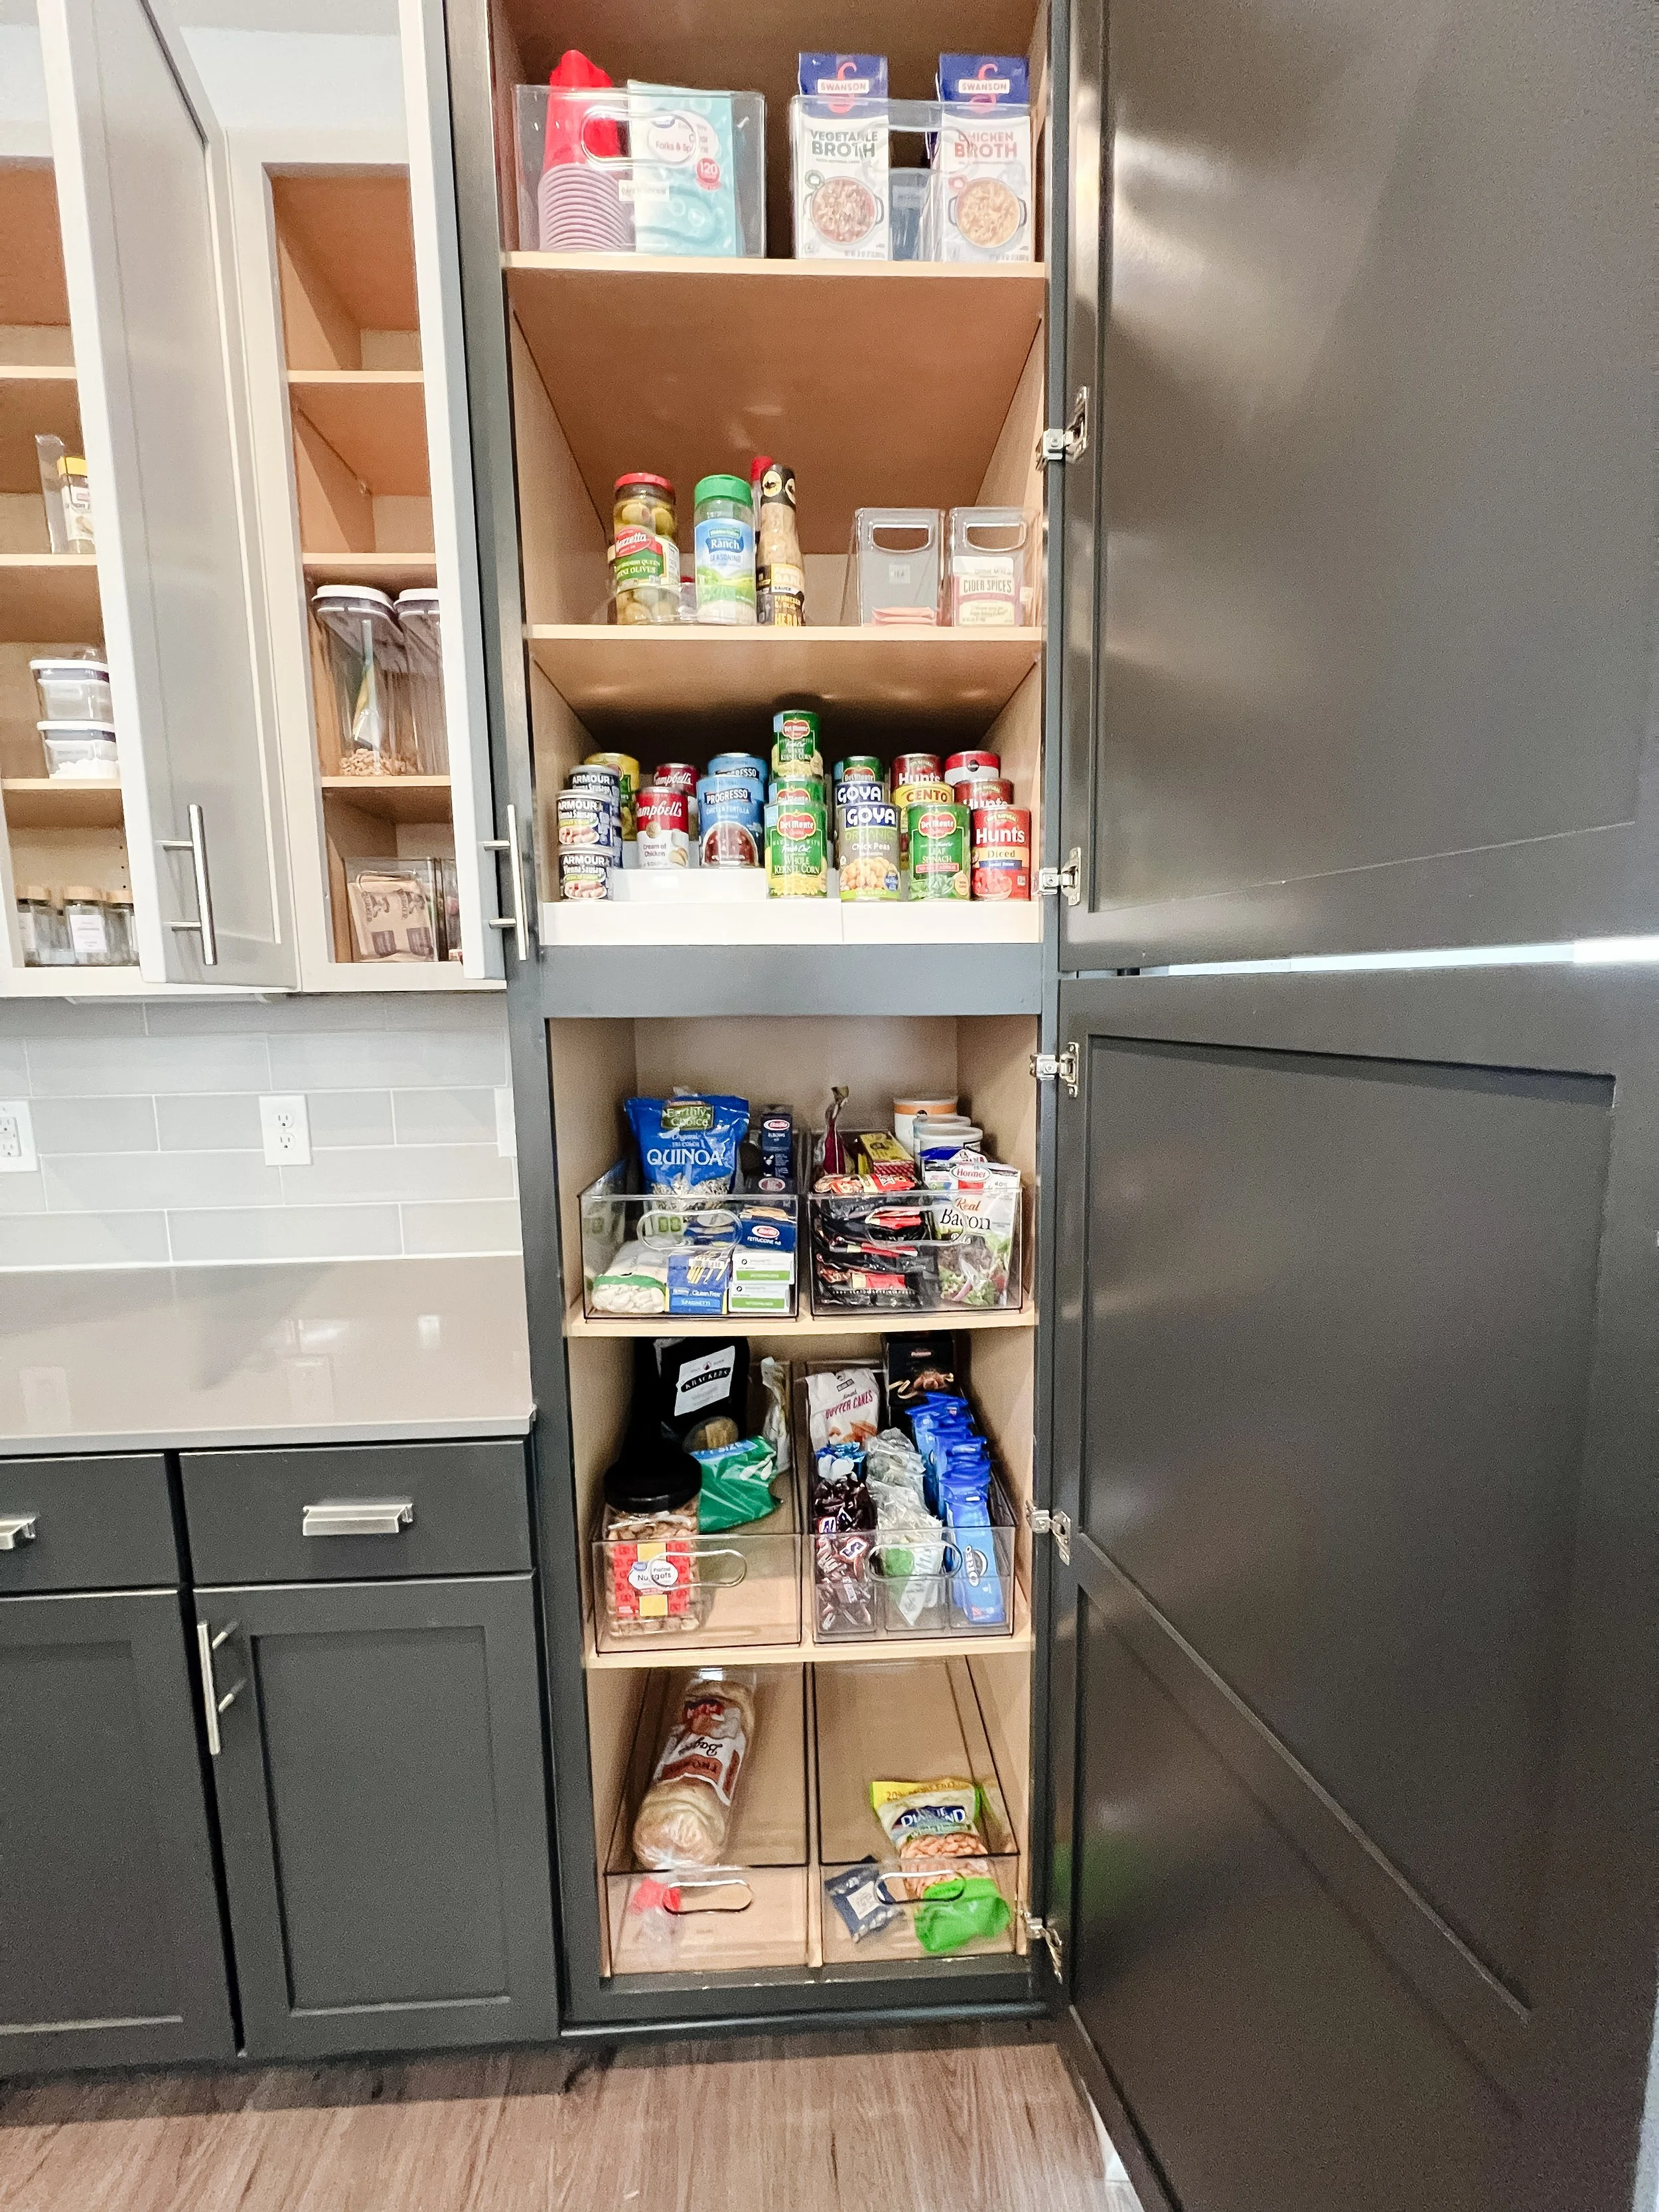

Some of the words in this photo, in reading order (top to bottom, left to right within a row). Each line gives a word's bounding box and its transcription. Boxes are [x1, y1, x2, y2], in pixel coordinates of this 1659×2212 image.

[820, 82, 867, 92] SWANSON
[962, 82, 1007, 92] SWANSON
[958, 132, 1014, 142] CHICKEN
[812, 141, 875, 159] BROTH
[954, 142, 1018, 159] BROTH
[699, 162, 718, 174] 120
[711, 540, 740, 550] Ranch
[710, 553, 741, 563] SEASONING
[964, 579, 985, 593] CIDER
[987, 579, 1012, 593] SPICES
[573, 774, 611, 784] ARMOUR
[706, 789, 748, 804] PROGRESSO
[837, 786, 882, 804] GOYA
[906, 789, 948, 802] CENTO
[558, 800, 599, 810] ARMOUR
[573, 810, 598, 822] Sausage
[847, 807, 895, 826] GOYA
[792, 820, 814, 829] Monte
[873, 842, 891, 851] Peas
[563, 855, 605, 865] ARMOUR
[801, 864, 820, 874] CORN
[647, 1149, 723, 1165] QUINOA
[956, 1169, 986, 1178] Hormel
[955, 1197, 981, 1211] Real
[940, 1209, 991, 1230] Bacon
[965, 1544, 979, 1587] OREO
[638, 1572, 672, 1582] Nugets
[901, 1807, 967, 1828] DIAND
